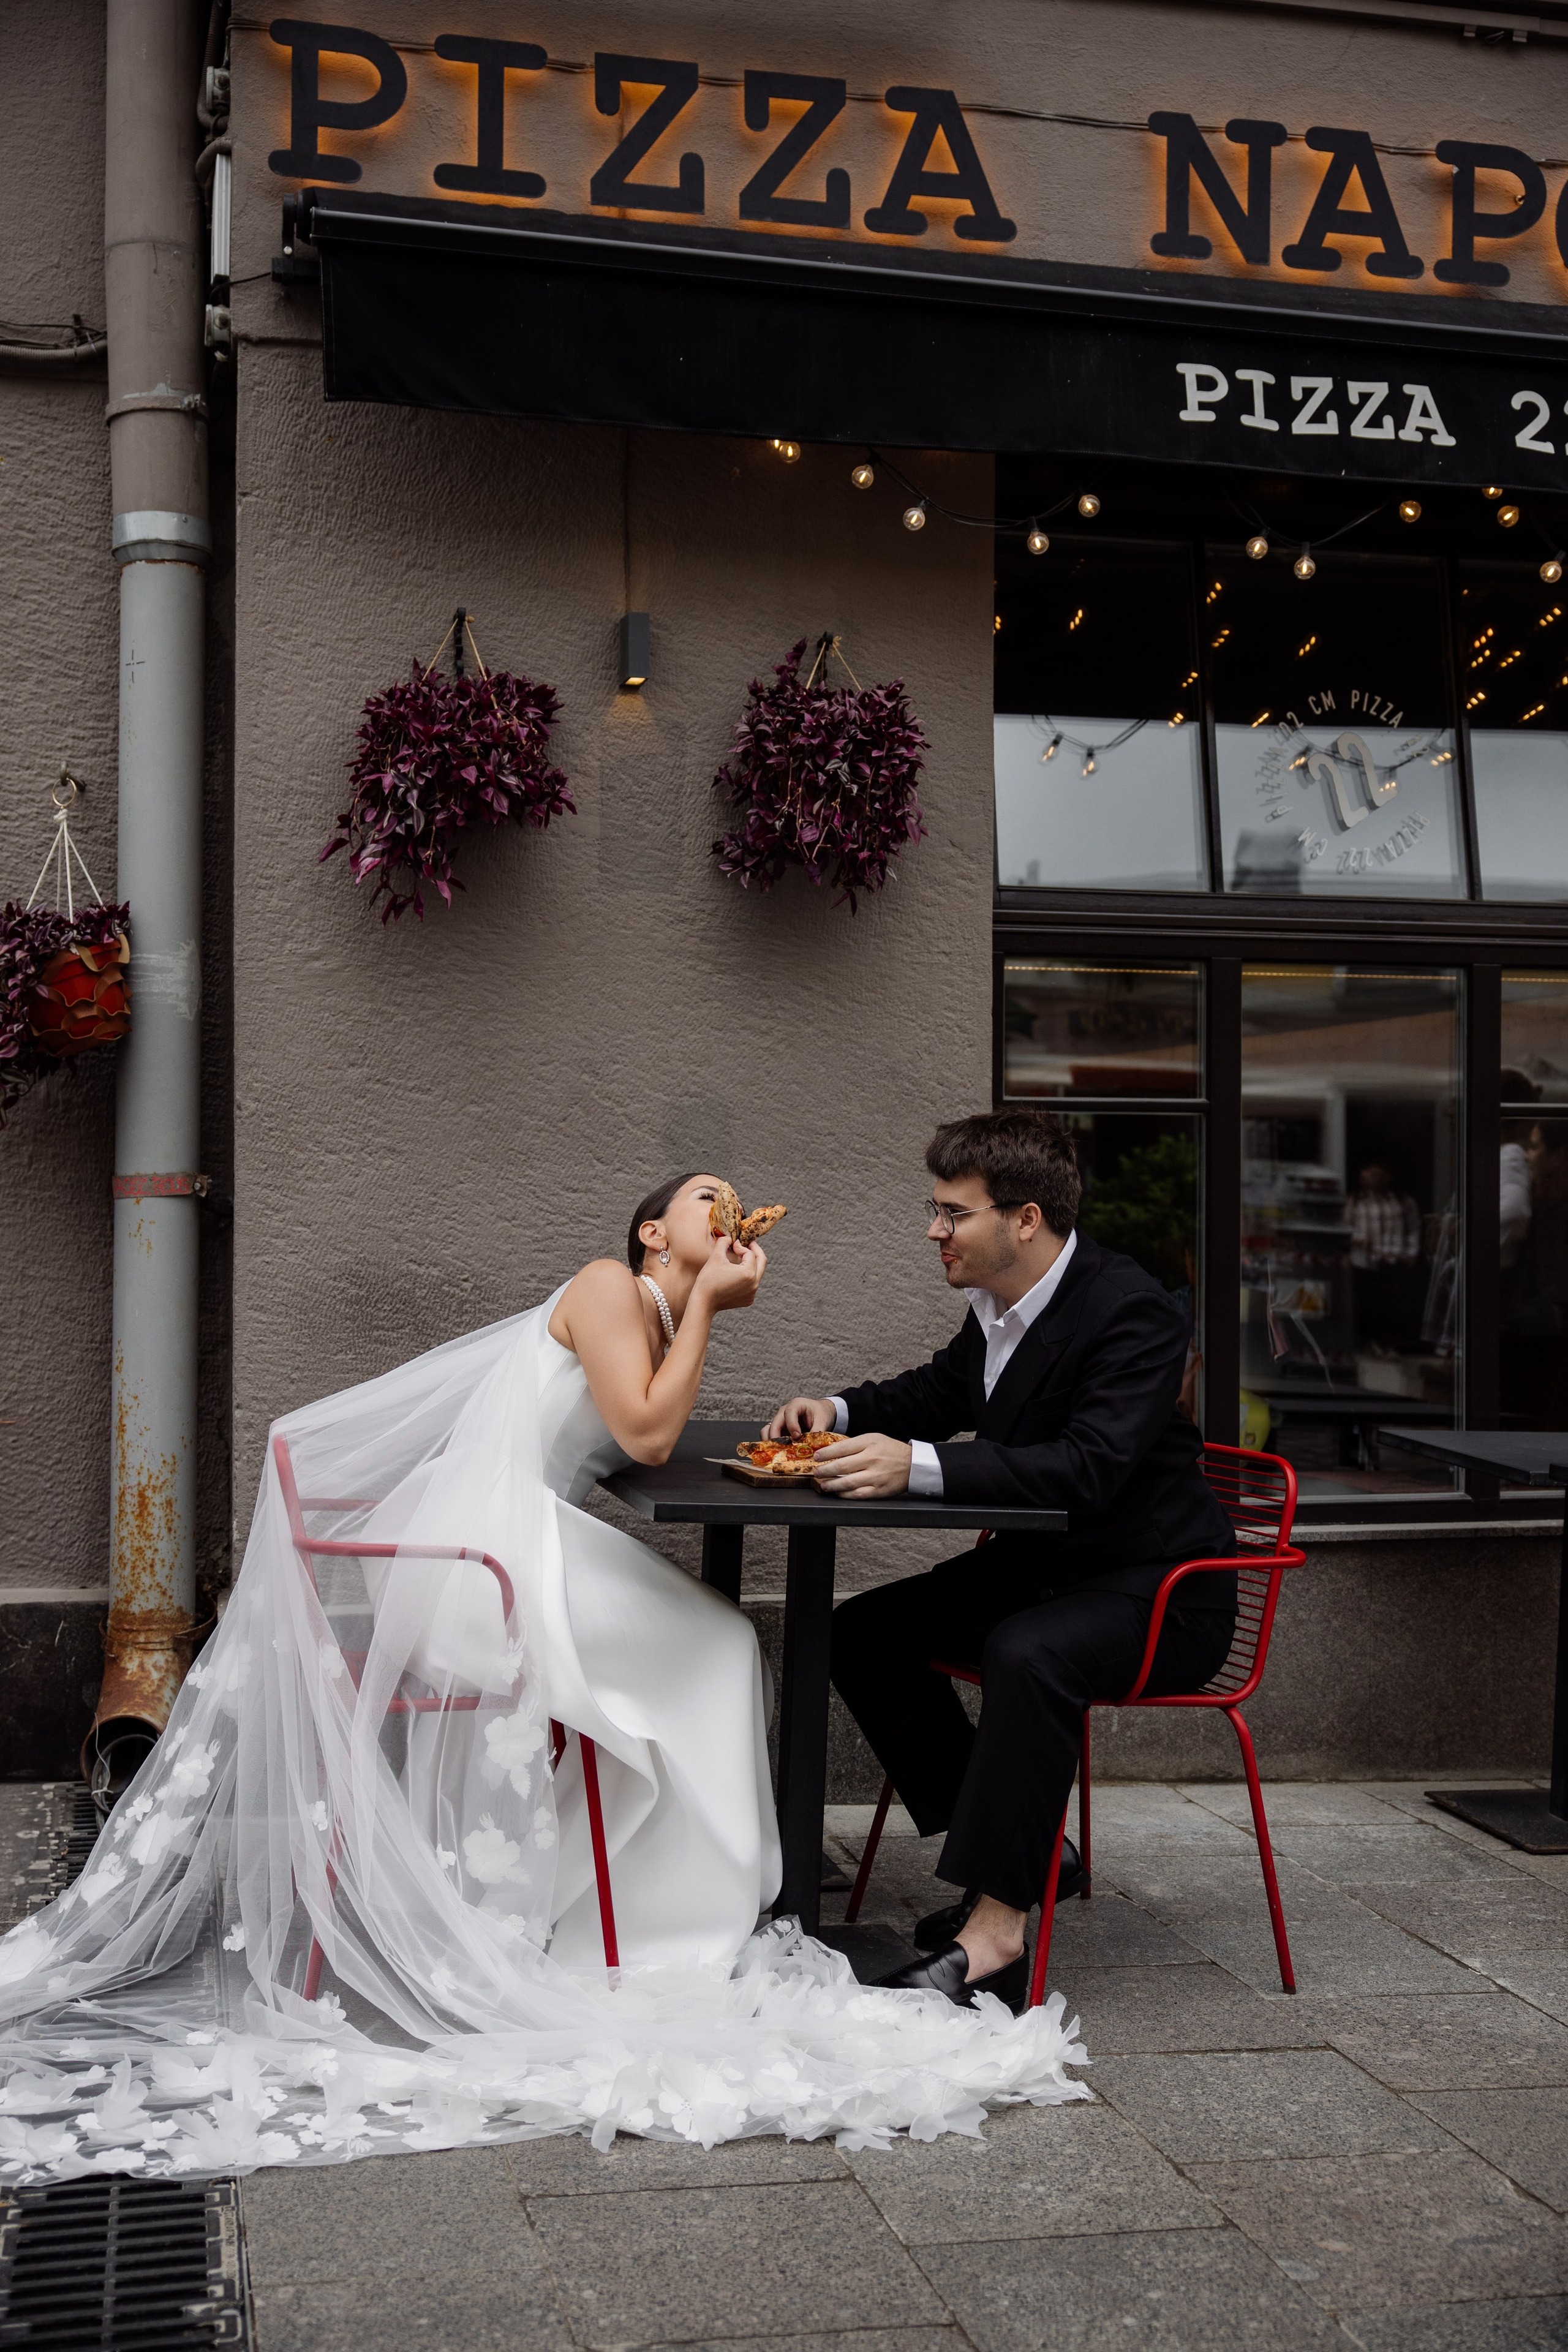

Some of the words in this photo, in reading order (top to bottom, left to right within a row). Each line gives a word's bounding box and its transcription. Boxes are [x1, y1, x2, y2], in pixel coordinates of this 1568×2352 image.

[268, 18, 1017, 243] PIZZA
[1148, 110, 1568, 287] NAP
[1175, 363, 1457, 447] PIZZA
[1510, 390, 1568, 456] 2
[1278, 710, 1304, 737] 22
[1308, 689, 1336, 715] CM
[1350, 688, 1404, 729] PIZZA
[1308, 731, 1399, 827] 22
